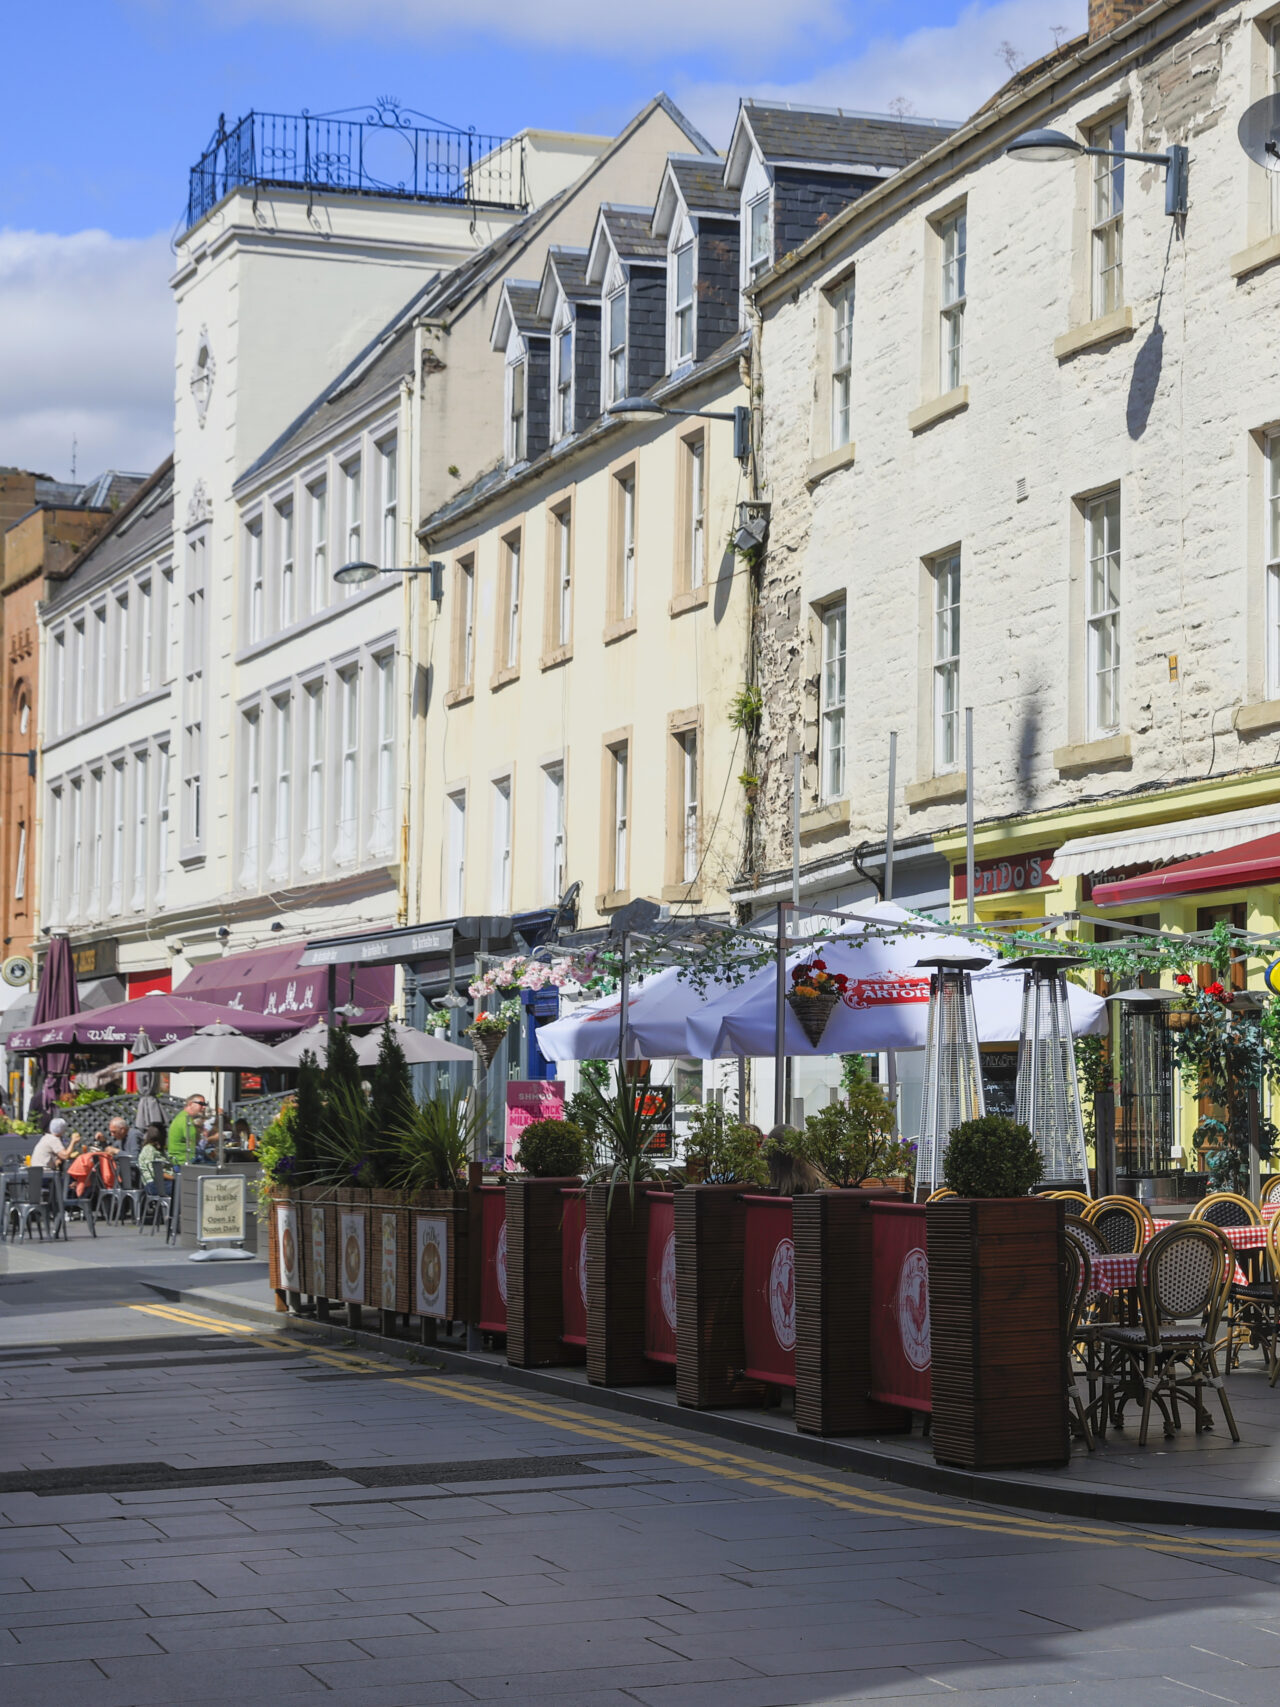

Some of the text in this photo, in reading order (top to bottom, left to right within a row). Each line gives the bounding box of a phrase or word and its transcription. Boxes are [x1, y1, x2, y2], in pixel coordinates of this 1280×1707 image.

[861, 982, 929, 990] STELLA
[863, 989, 931, 998] ARTOIS
[207, 1215, 236, 1224] Open 12
